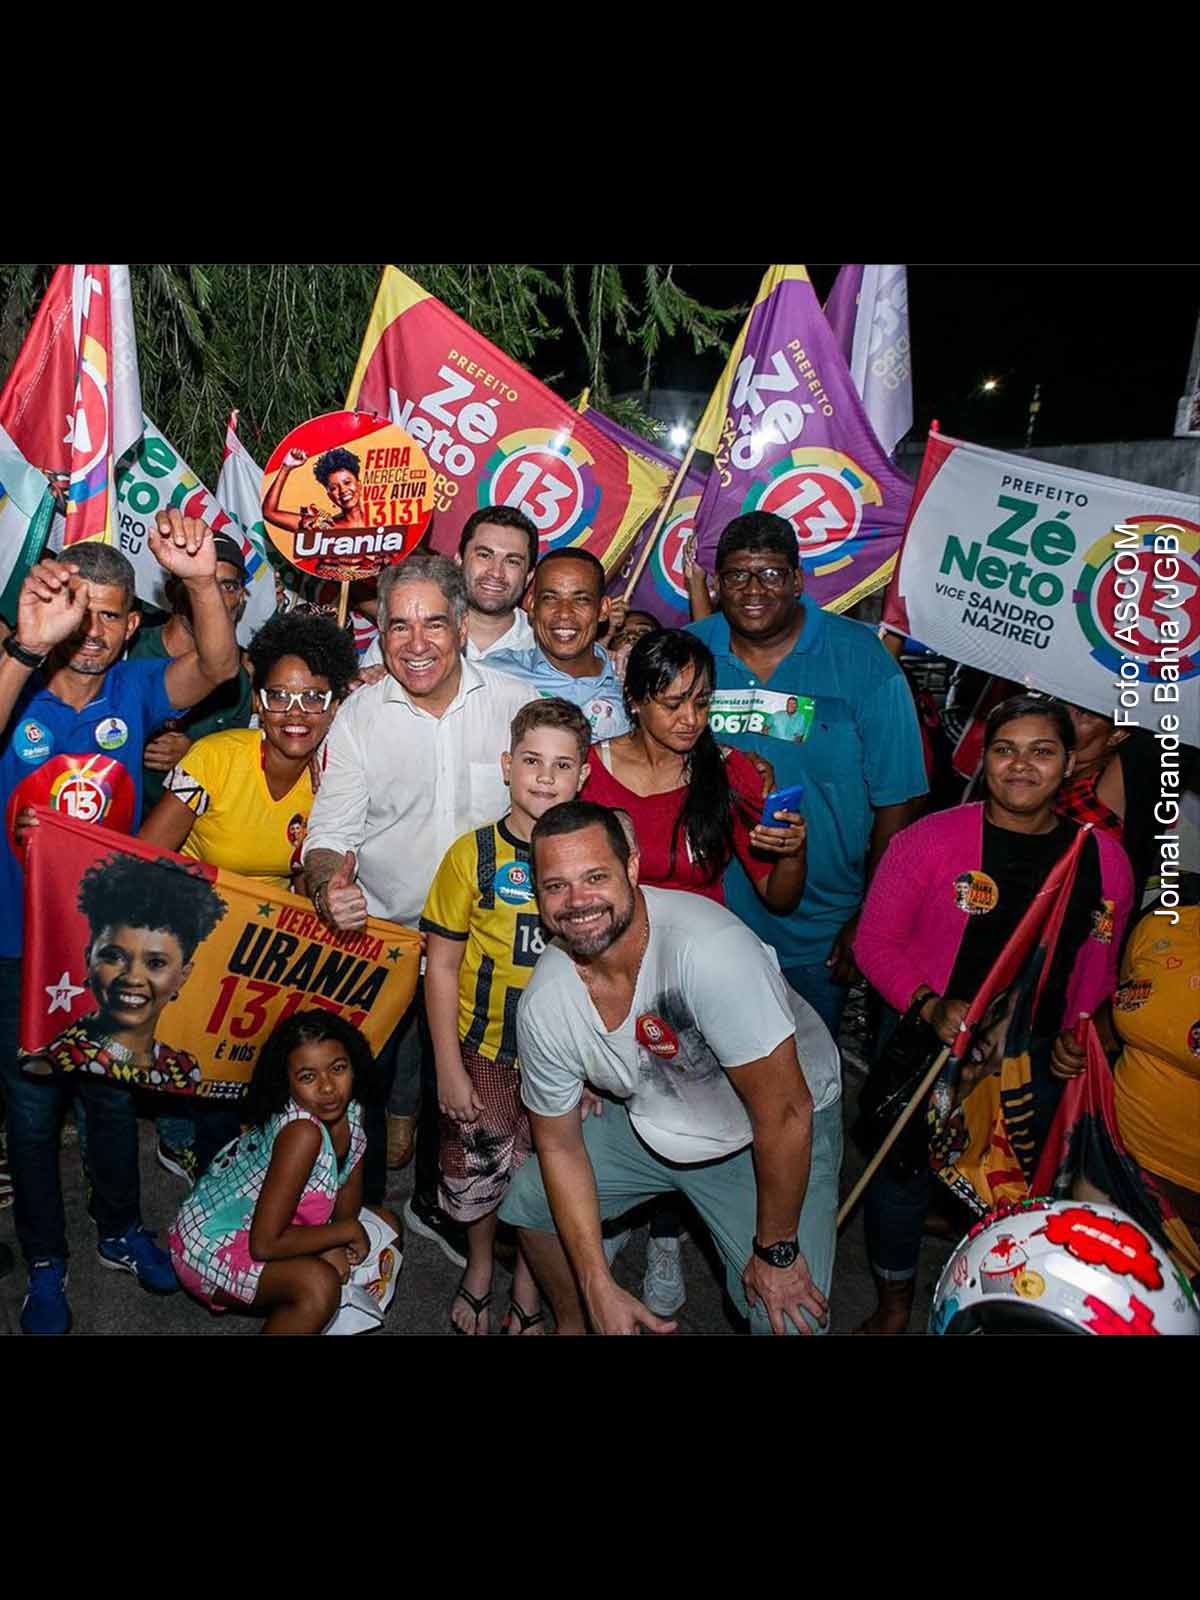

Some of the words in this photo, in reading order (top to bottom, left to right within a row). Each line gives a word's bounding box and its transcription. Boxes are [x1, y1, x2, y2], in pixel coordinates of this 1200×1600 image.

[447, 350, 519, 403] PREFEITO
[788, 339, 834, 418] PREFEITO
[418, 365, 501, 445] Zé
[388, 387, 476, 477] Neto
[362, 468, 409, 484] MERECE
[365, 446, 412, 470] FEIRA
[362, 484, 386, 501] VOZ
[390, 482, 427, 499] ATIVA
[363, 499, 424, 526] 13131
[503, 460, 574, 529] 13
[770, 478, 838, 545] 13
[1001, 475, 1089, 508] PREFEITO
[295, 527, 403, 557] Urania
[986, 494, 1076, 566] Zé
[939, 535, 1065, 607] Neto
[934, 581, 967, 602] VICE
[967, 590, 1055, 632] SANDRO
[960, 608, 1051, 650] NAZIREU
[62, 789, 99, 820] 13
[275, 905, 385, 962] VEREADORA
[227, 922, 390, 1012] URANIA
[55, 989, 71, 1001] PT
[215, 1040, 228, 1060] É
[228, 1043, 255, 1062] NÓS
